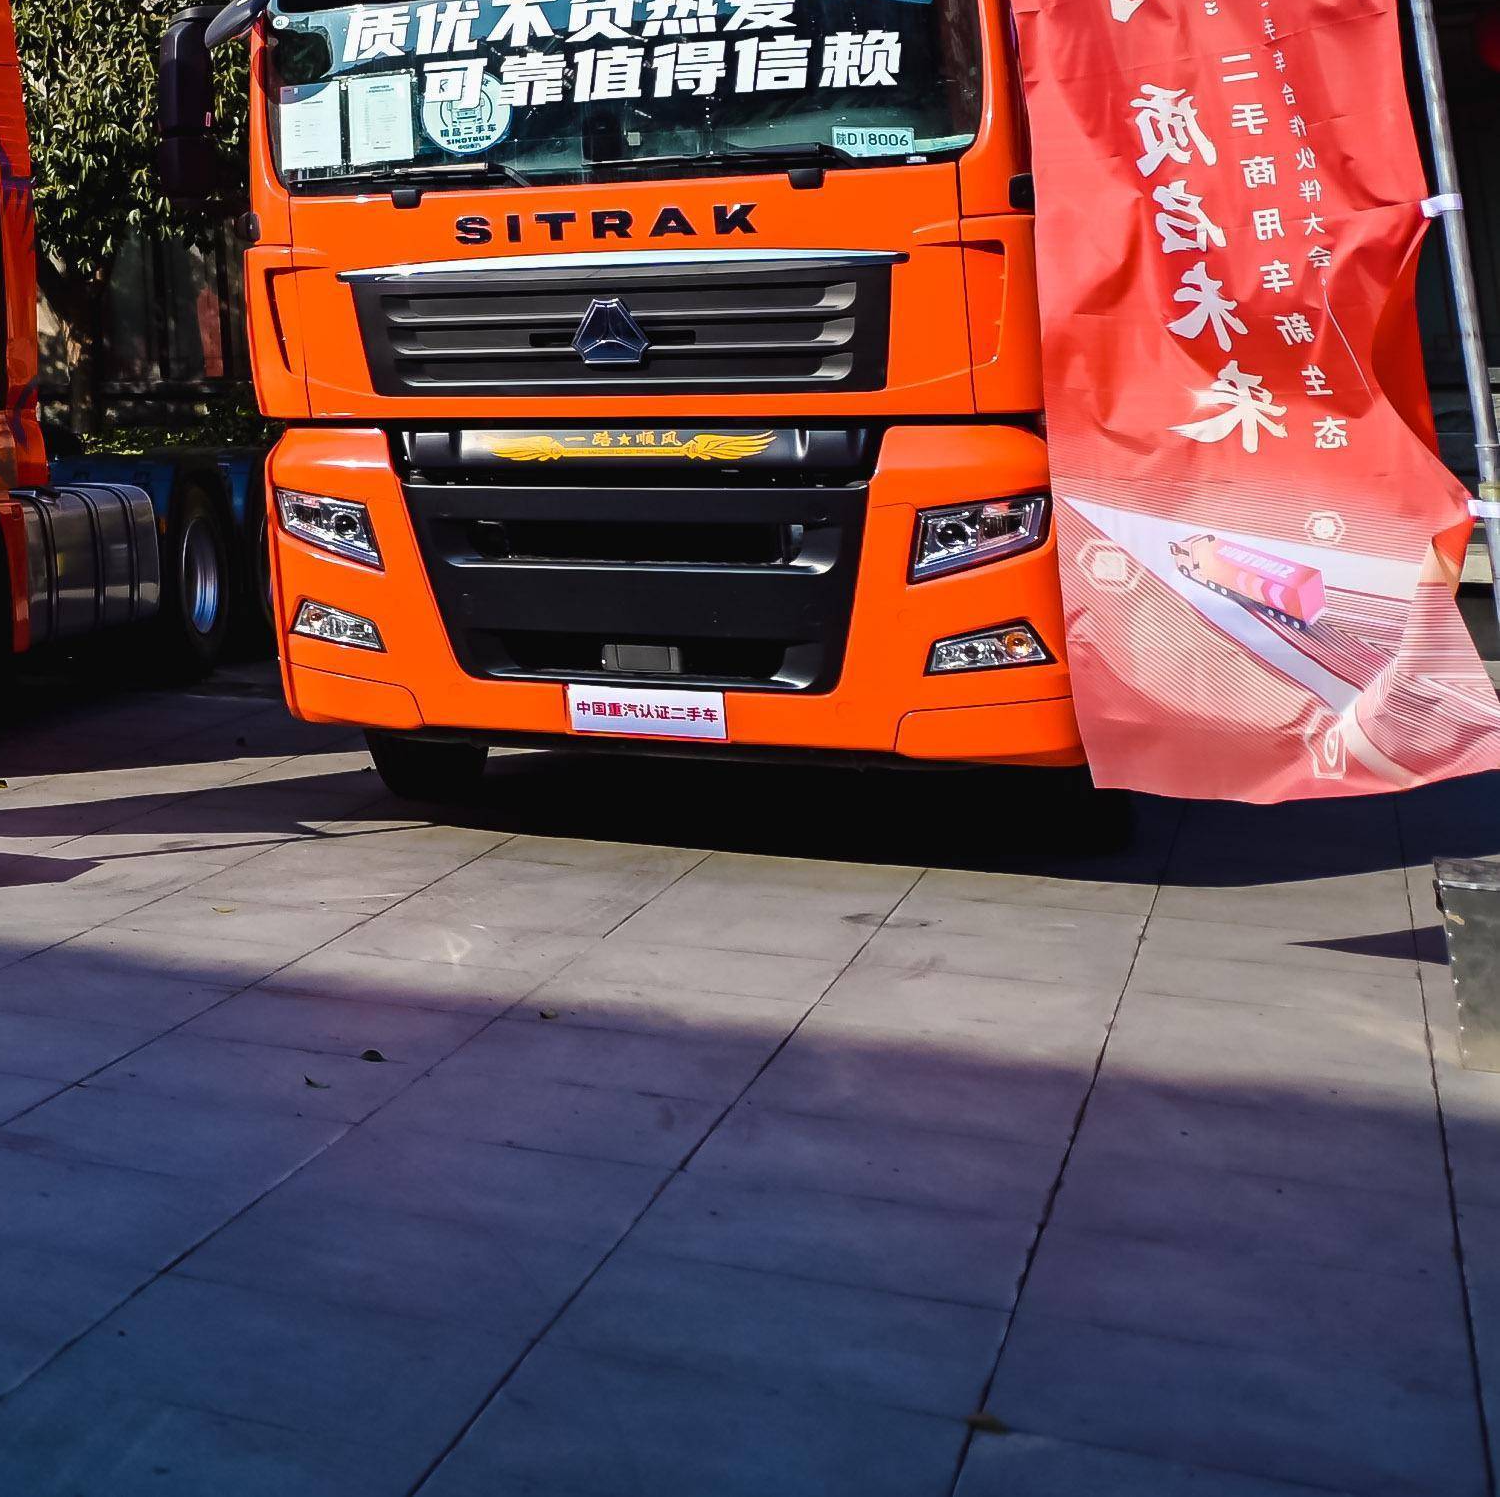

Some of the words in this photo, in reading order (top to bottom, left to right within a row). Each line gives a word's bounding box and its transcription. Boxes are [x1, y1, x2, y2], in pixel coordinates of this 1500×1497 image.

[422, 30, 902, 109] 可靠值得信赖
[455, 203, 759, 245] SITRAK
[576, 700, 719, 723] 中国重汽认证二手车
